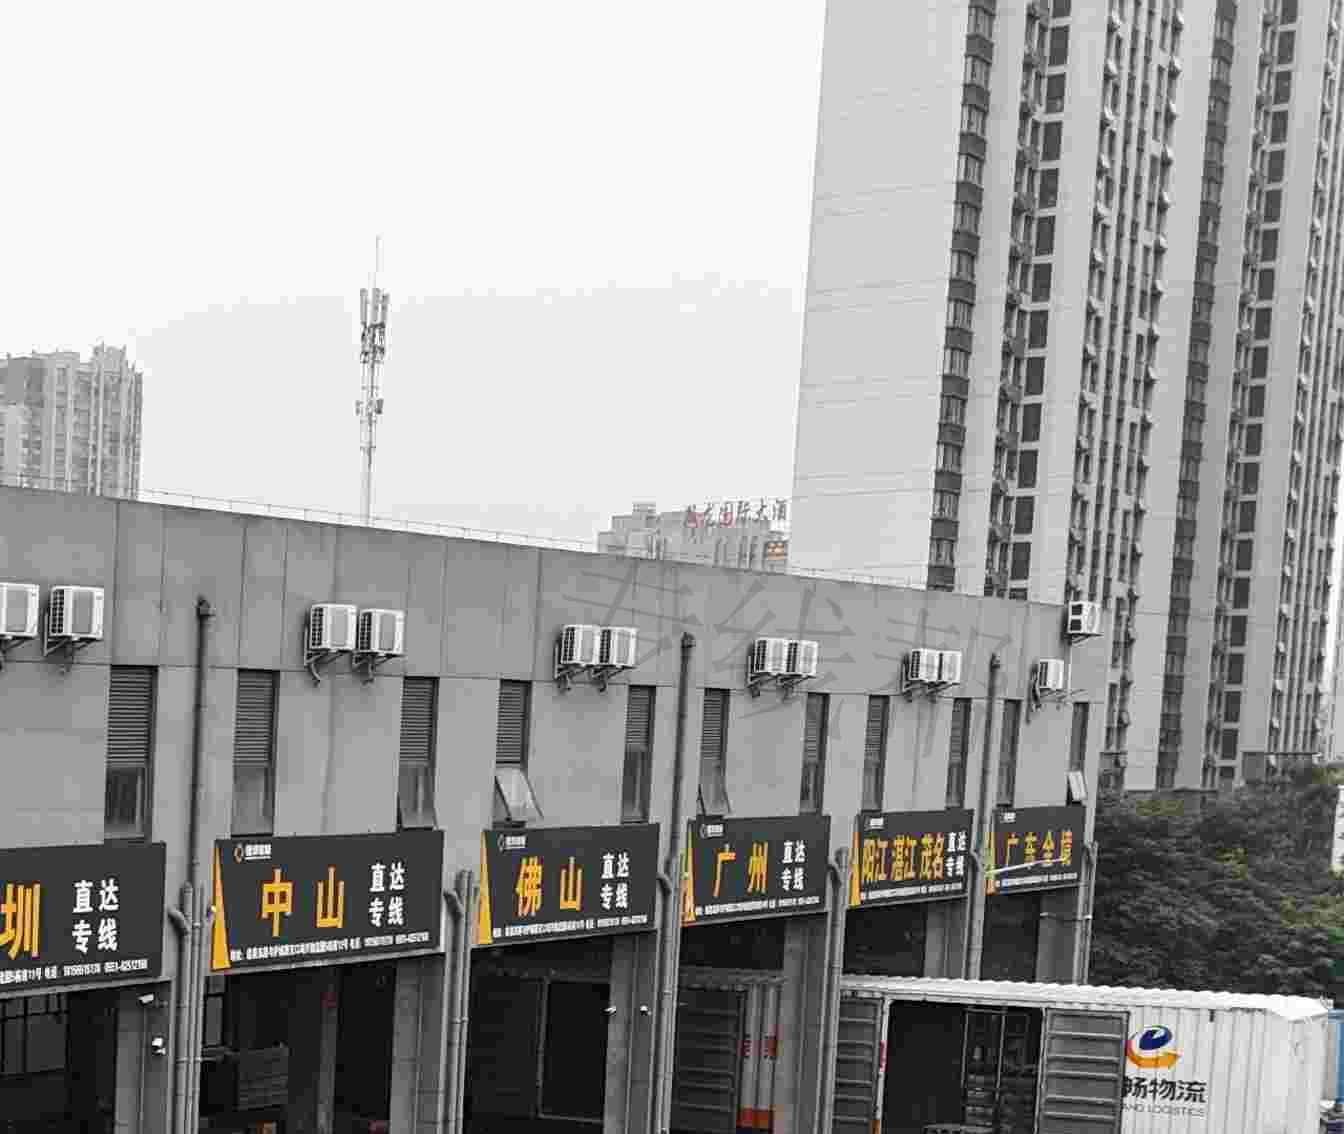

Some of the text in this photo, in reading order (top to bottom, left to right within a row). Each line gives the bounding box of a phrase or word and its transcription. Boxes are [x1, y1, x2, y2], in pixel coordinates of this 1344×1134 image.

[601, 852, 629, 879] 直达
[782, 840, 805, 863] 直达
[370, 862, 404, 892] 直达
[713, 841, 768, 898] 广州
[781, 868, 804, 891] 专线
[73, 879, 119, 913] 直达
[262, 866, 345, 937] 中山
[516, 857, 583, 917] 佛山
[600, 883, 628, 910] 专线
[369, 897, 404, 927] 专线
[72, 918, 118, 953] 专线
